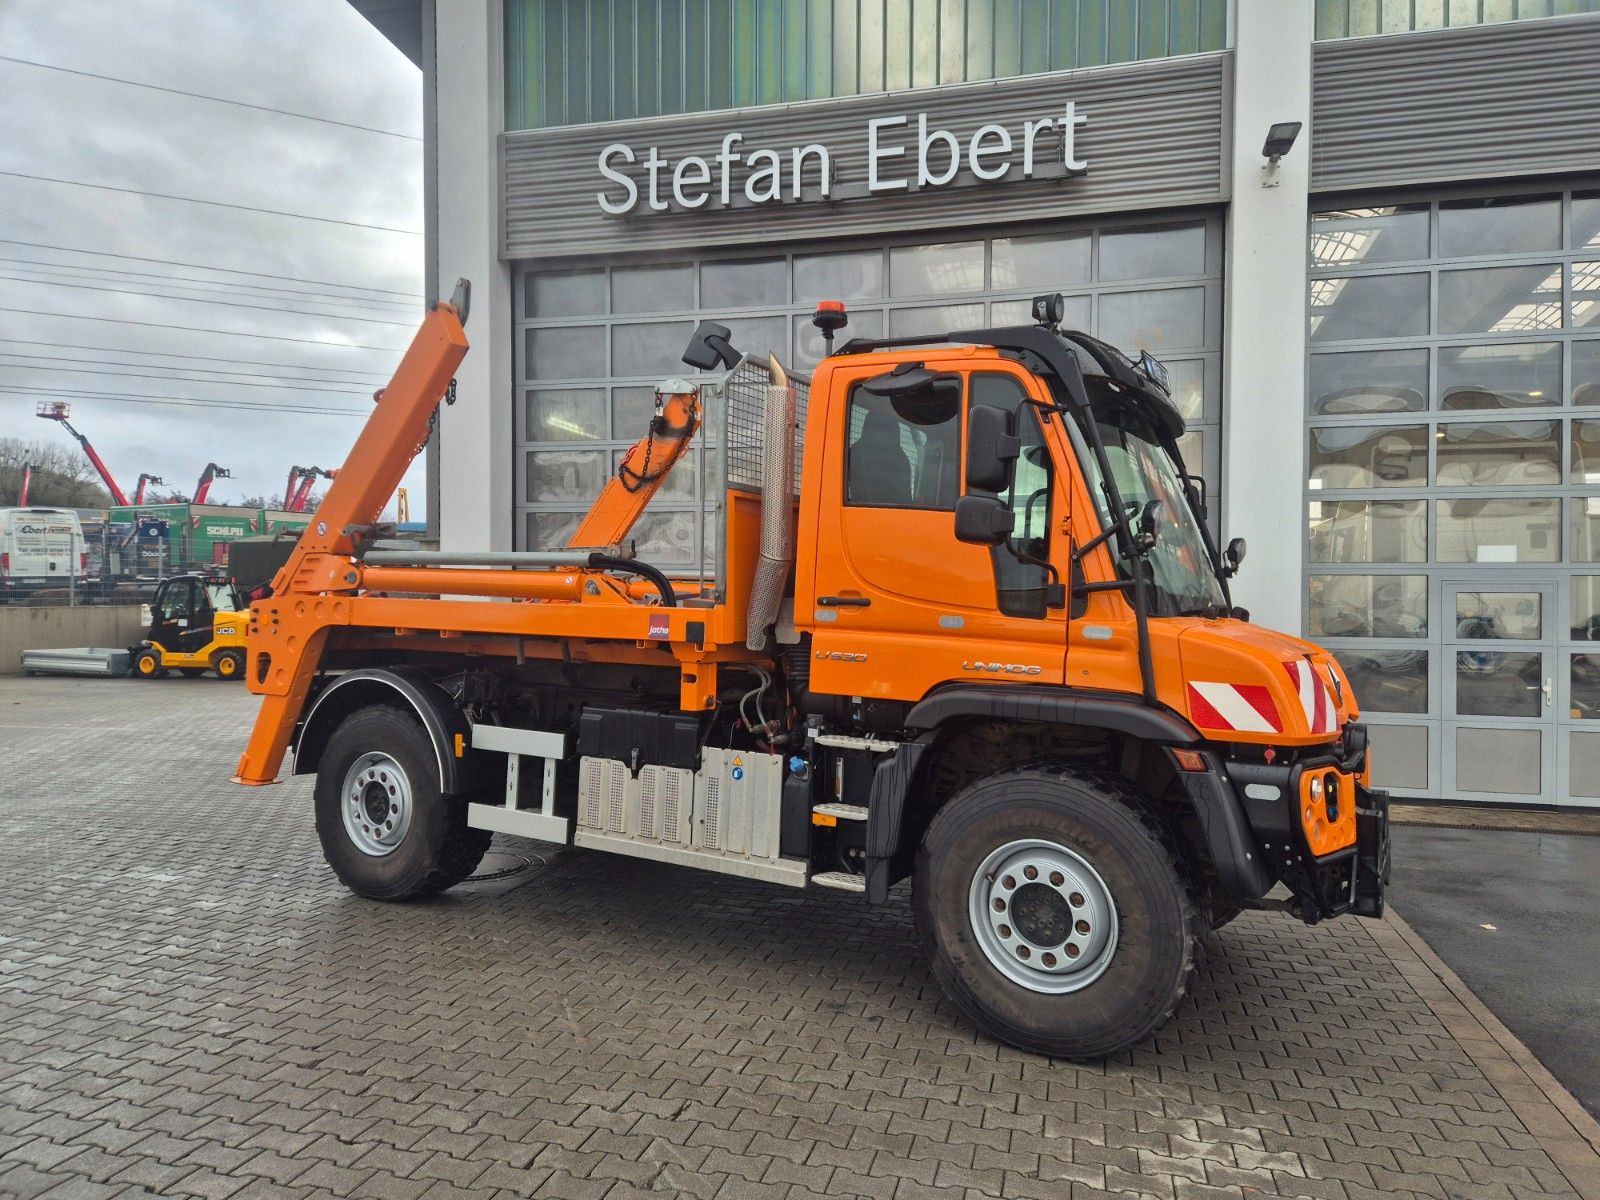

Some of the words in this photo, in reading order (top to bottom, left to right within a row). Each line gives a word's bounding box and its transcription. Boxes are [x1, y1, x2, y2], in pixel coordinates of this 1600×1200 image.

[597, 132, 830, 214] Stefan
[867, 101, 1088, 192] Ebert
[216, 627, 236, 635] JCB
[648, 625, 669, 636] jotha
[962, 660, 1042, 675] UNIMOG
